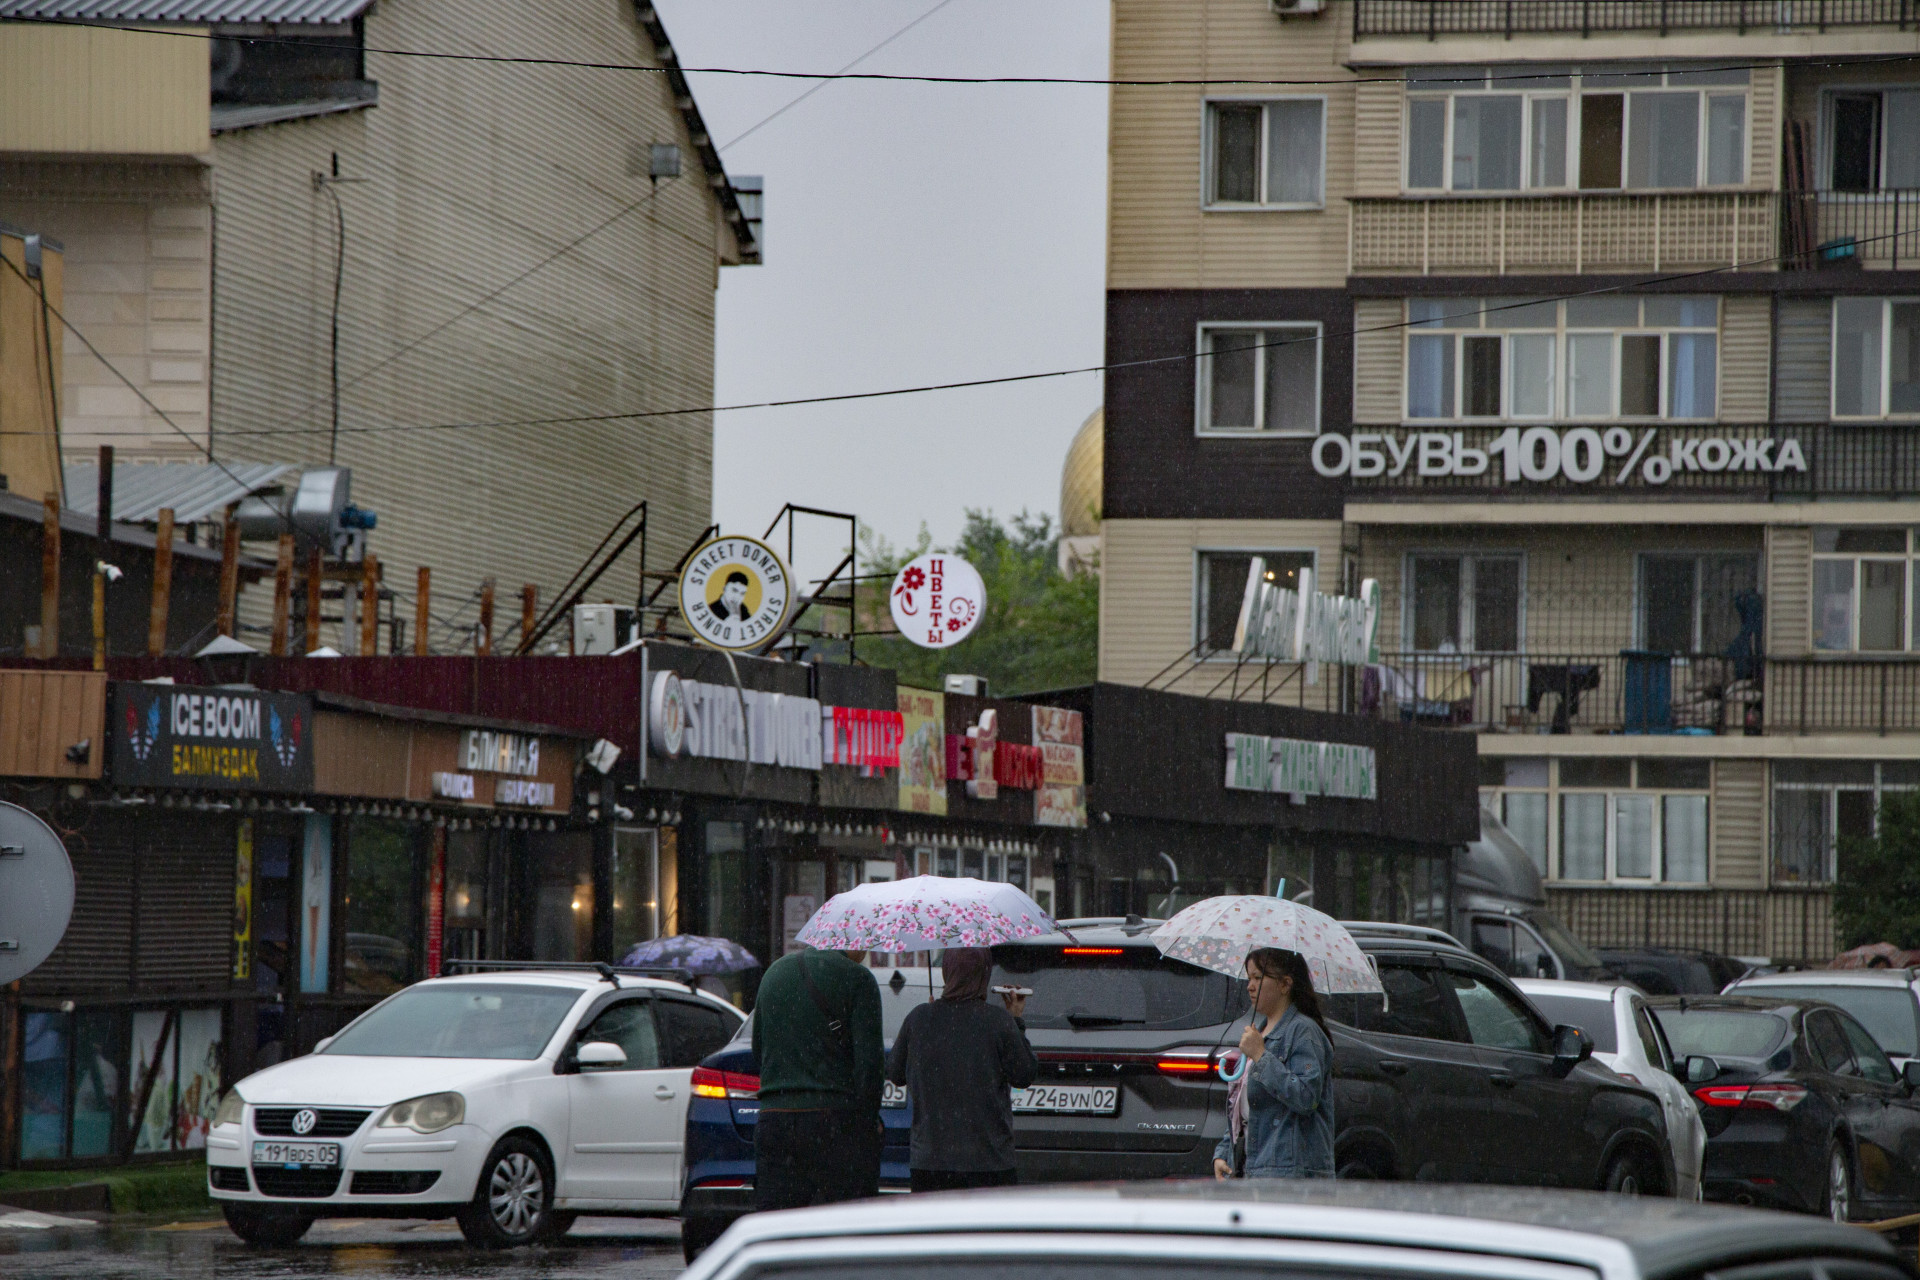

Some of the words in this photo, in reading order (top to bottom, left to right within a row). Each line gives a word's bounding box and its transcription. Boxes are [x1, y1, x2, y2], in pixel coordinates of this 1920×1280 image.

[1311, 432, 1488, 477] ОБУВЬ
[1489, 427, 1672, 484] 100%
[1671, 438, 1807, 471] КОЖА
[690, 543, 734, 585] STREET
[742, 544, 781, 584] DONER
[691, 601, 731, 640] DONER
[739, 597, 782, 641] STREET
[927, 559, 944, 643] ЦВЕТЫ
[170, 693, 201, 736] ICE
[203, 695, 261, 739] BOOM
[466, 730, 540, 776] БЛИННАЯ
[1026, 1088, 1091, 1108] 724BVN
[1093, 1089, 1115, 1109] 02
[317, 1146, 337, 1163] 05
